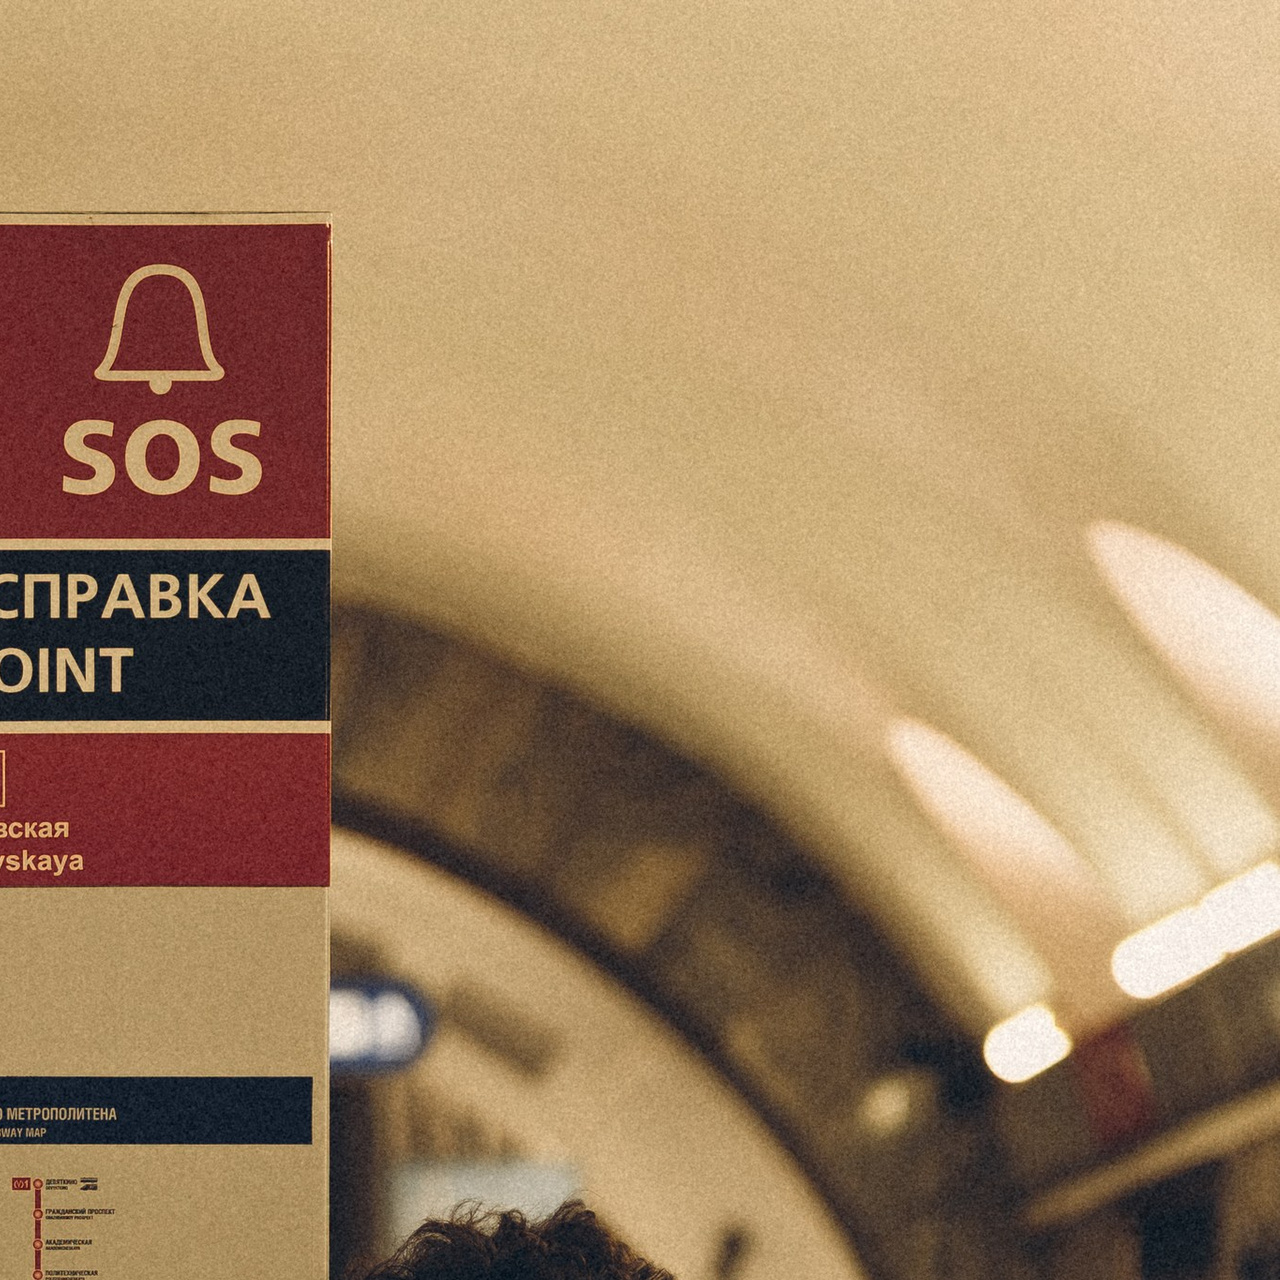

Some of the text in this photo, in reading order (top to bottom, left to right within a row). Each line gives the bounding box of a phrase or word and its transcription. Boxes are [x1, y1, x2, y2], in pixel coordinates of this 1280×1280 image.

[62, 419, 263, 496] SOS
[6, 1107, 117, 1122] МЕТРОПОЛИТЕНА
[25, 1127, 47, 1139] MAP
